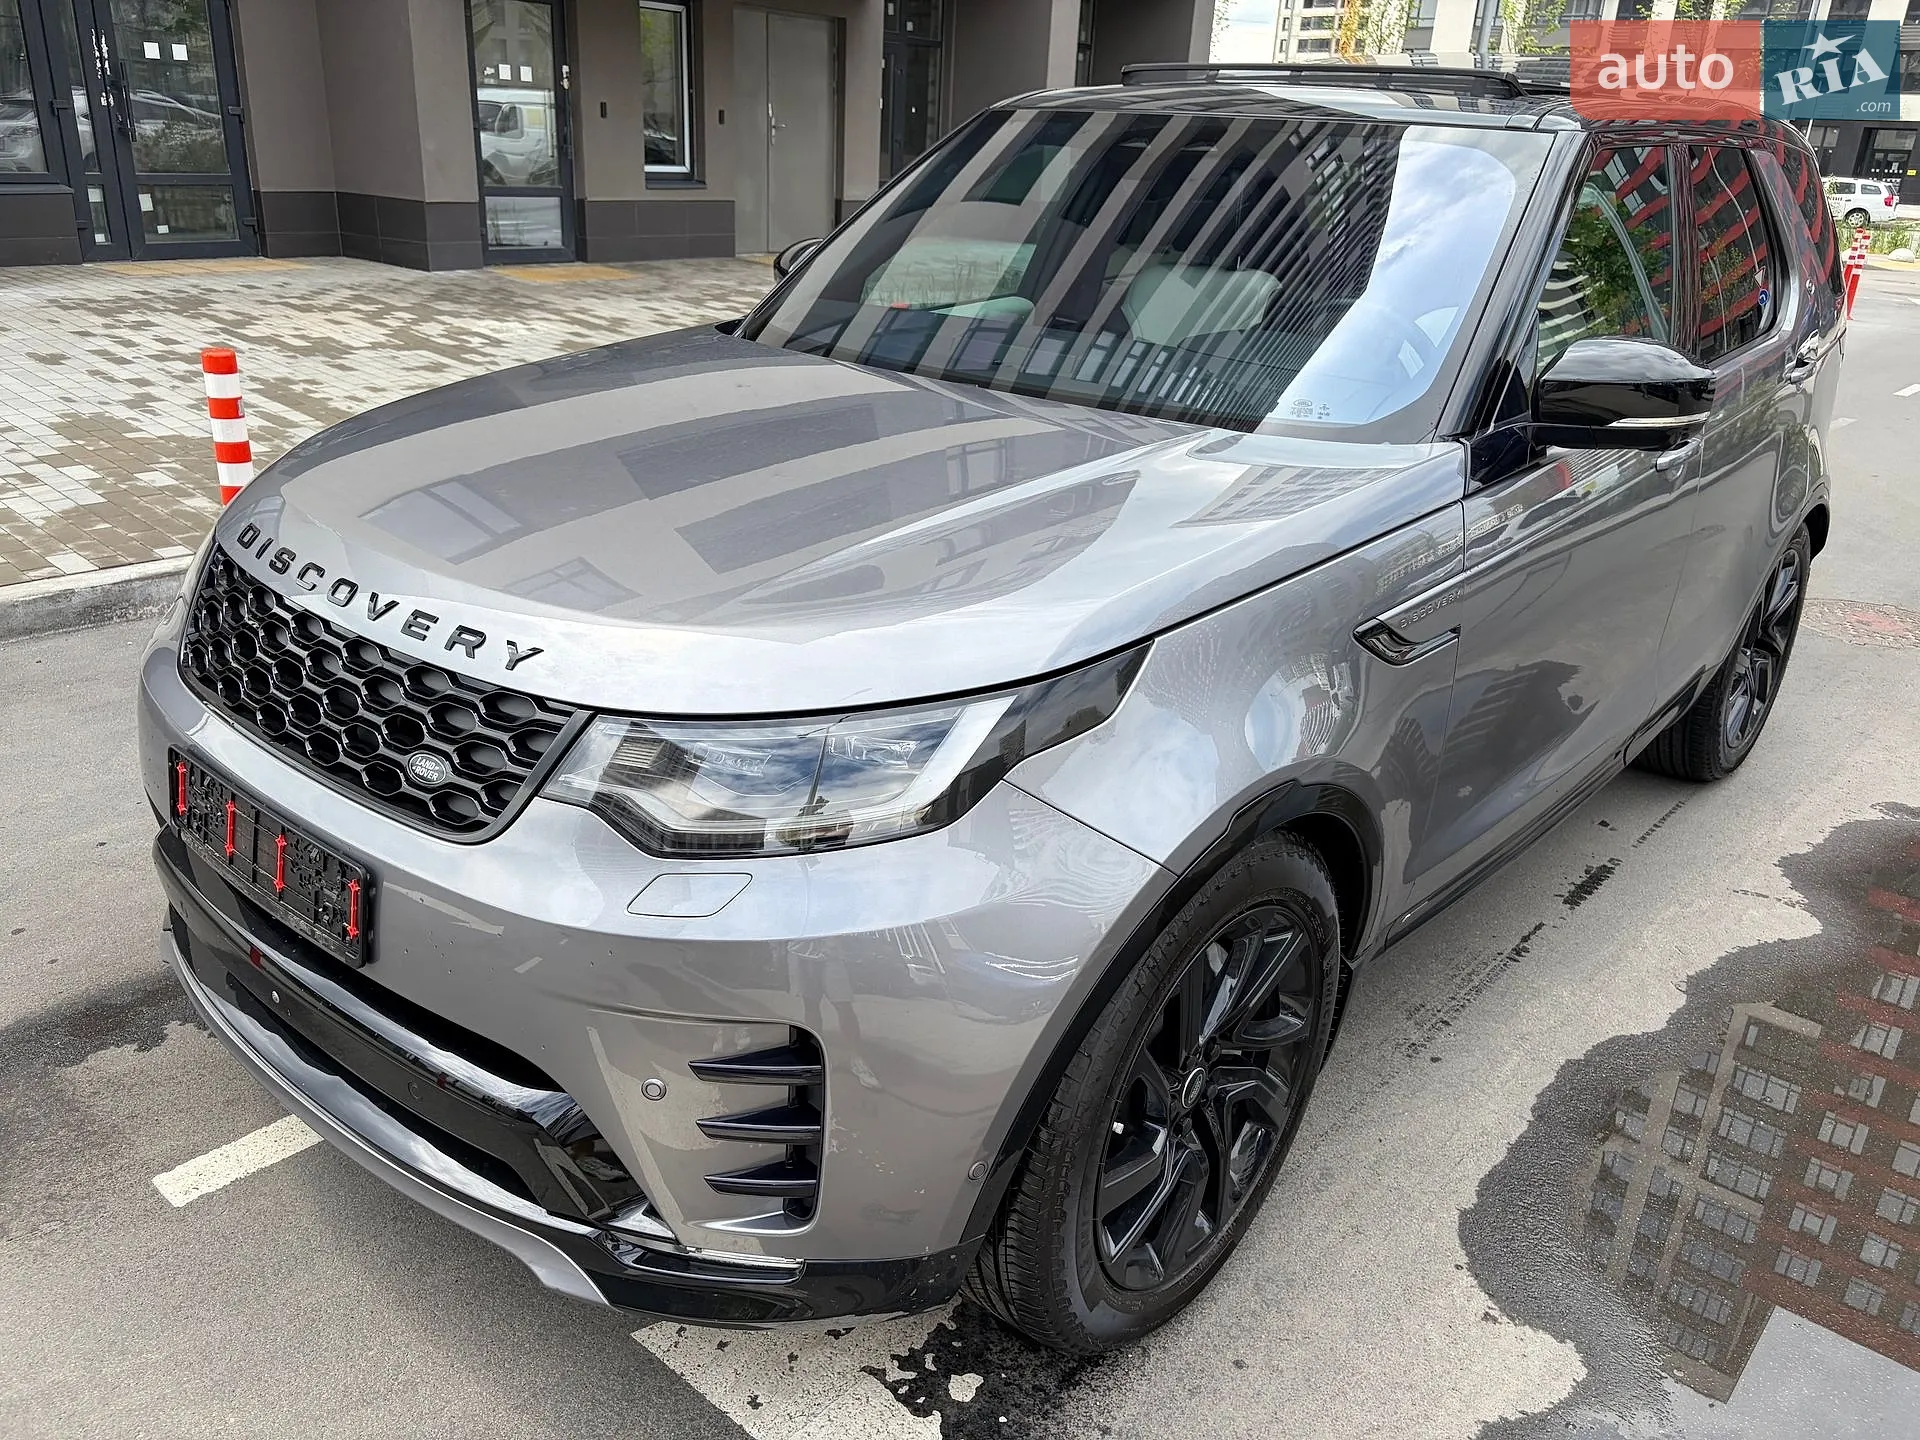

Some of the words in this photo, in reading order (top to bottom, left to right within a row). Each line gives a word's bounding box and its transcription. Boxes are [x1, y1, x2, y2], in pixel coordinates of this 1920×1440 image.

[237, 523, 545, 671] DISCOVERY
[415, 756, 435, 770] LAND
[414, 765, 439, 781] ROVER
